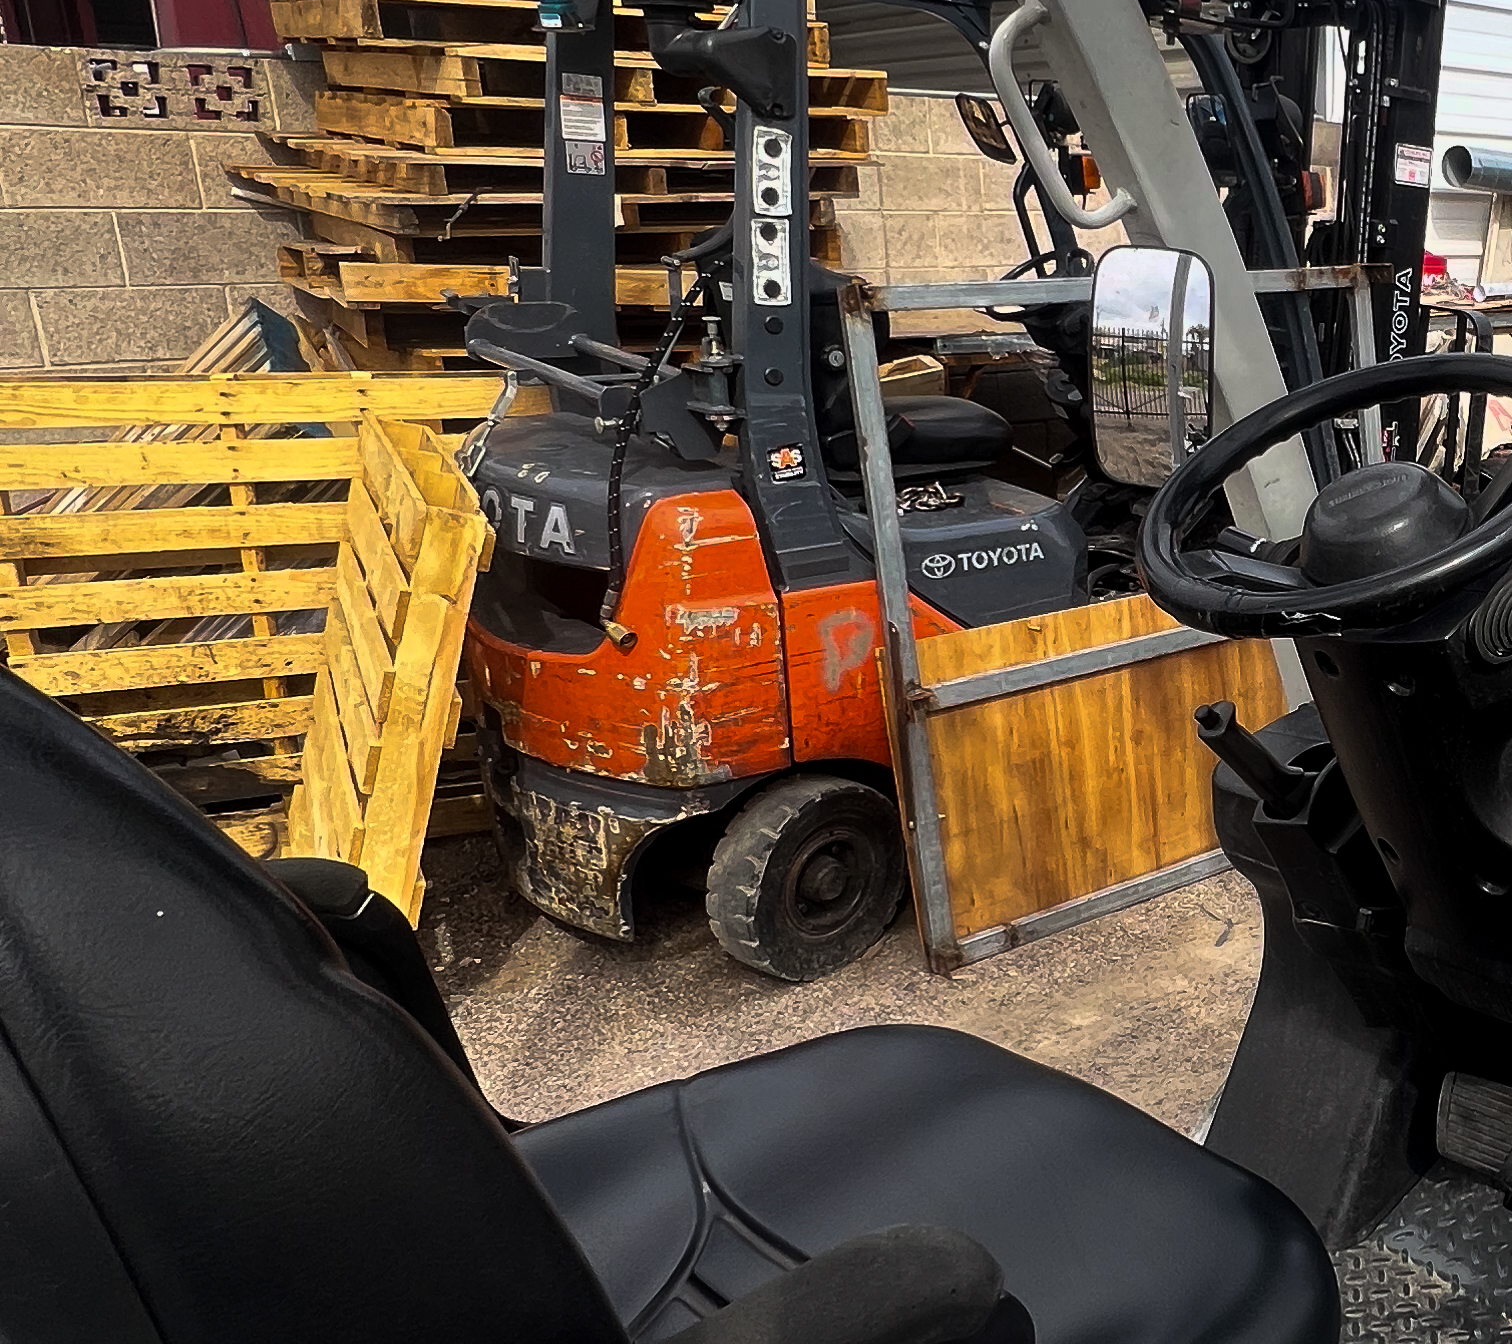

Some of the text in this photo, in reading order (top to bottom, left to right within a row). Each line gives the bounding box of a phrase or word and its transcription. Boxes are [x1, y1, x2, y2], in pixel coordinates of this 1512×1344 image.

[1389, 267, 1413, 362] YOTA
[770, 447, 803, 469] SAS
[481, 489, 576, 555] OTA
[957, 542, 1045, 571] TOYOTA
